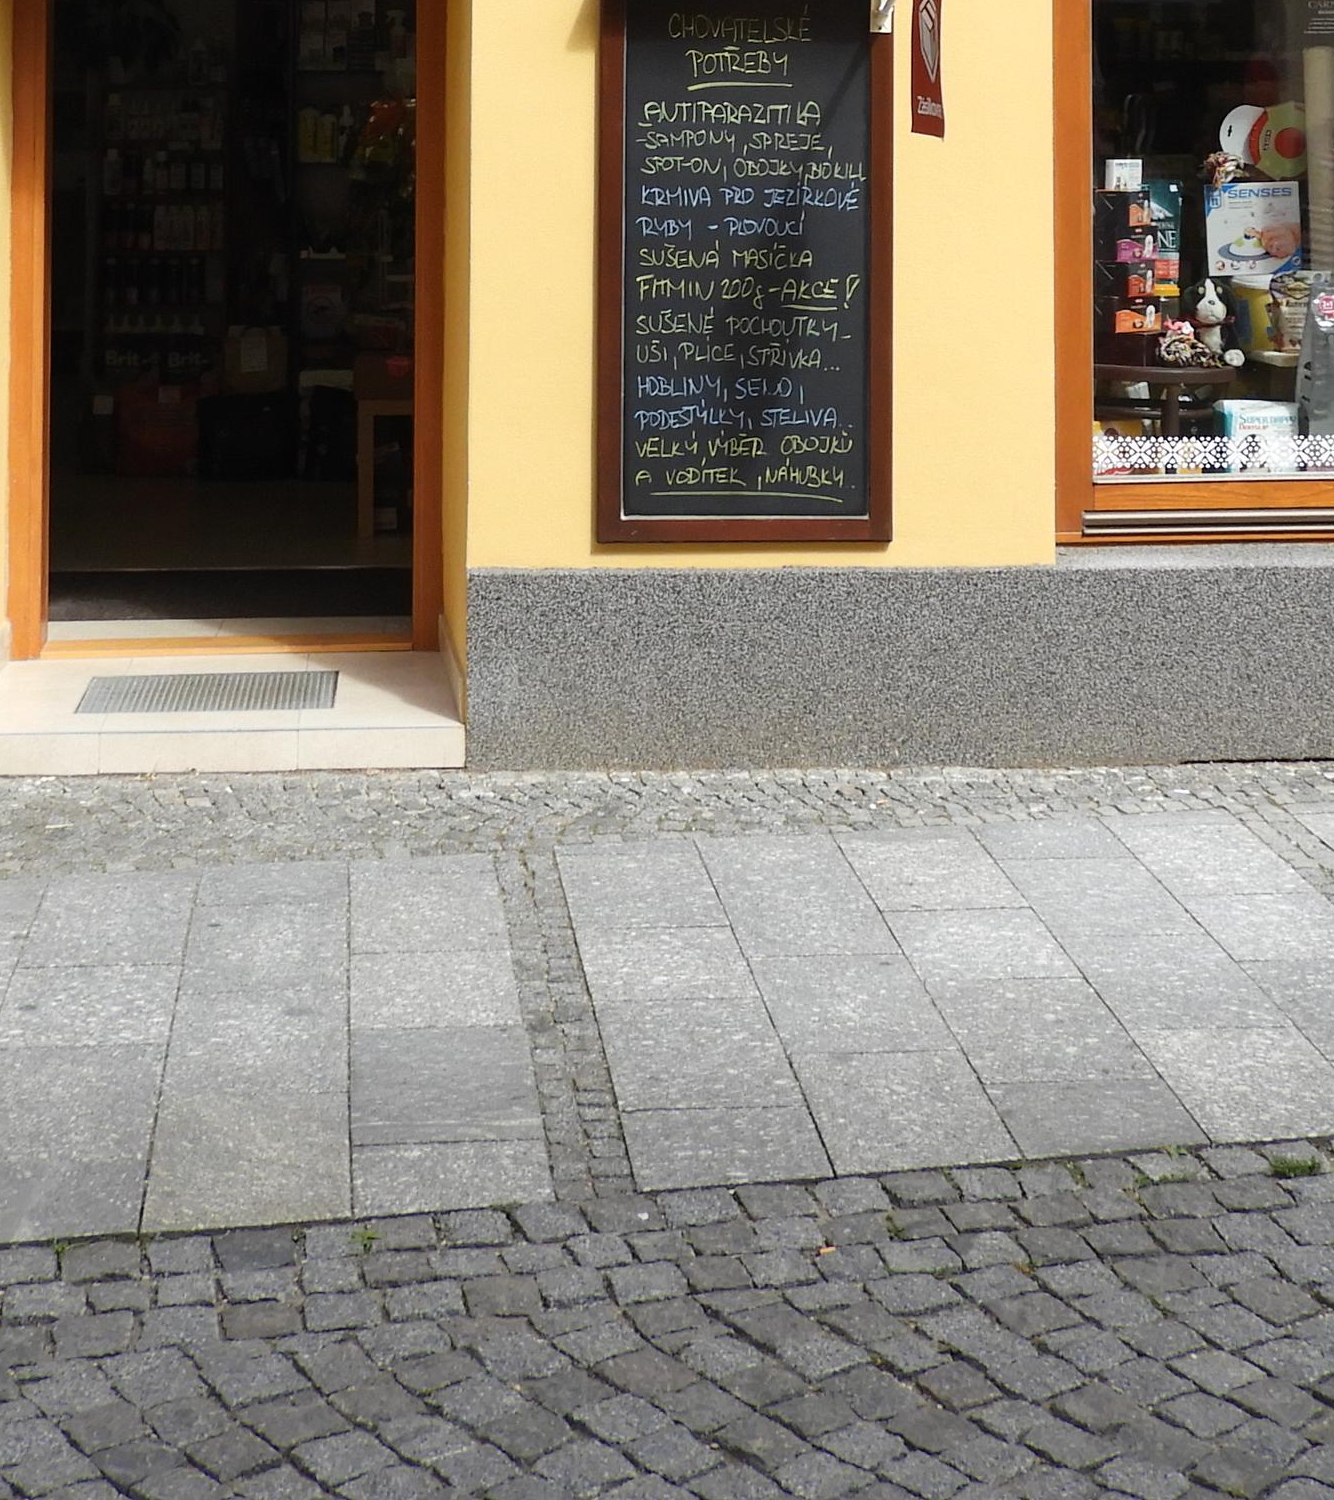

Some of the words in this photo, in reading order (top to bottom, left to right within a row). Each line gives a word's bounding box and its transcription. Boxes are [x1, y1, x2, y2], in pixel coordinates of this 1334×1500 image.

[668, 4, 811, 43] CHOVATELSKÉ
[686, 45, 788, 78] POTŘEBY
[640, 184, 712, 208] KRMIVA
[720, 186, 755, 206] PRO
[1227, 187, 1293, 199] SENSES
[636, 214, 693, 238] RYBY
[723, 211, 807, 237] PLOVOUCÍ
[639, 240, 719, 269] SUŠENÁ
[733, 242, 813, 271] MASÍČKA
[635, 306, 715, 336] SUŠENÉ
[635, 431, 697, 459] VELKÝ
[708, 429, 765, 458] VÝBĚR
[635, 471, 652, 487] A
